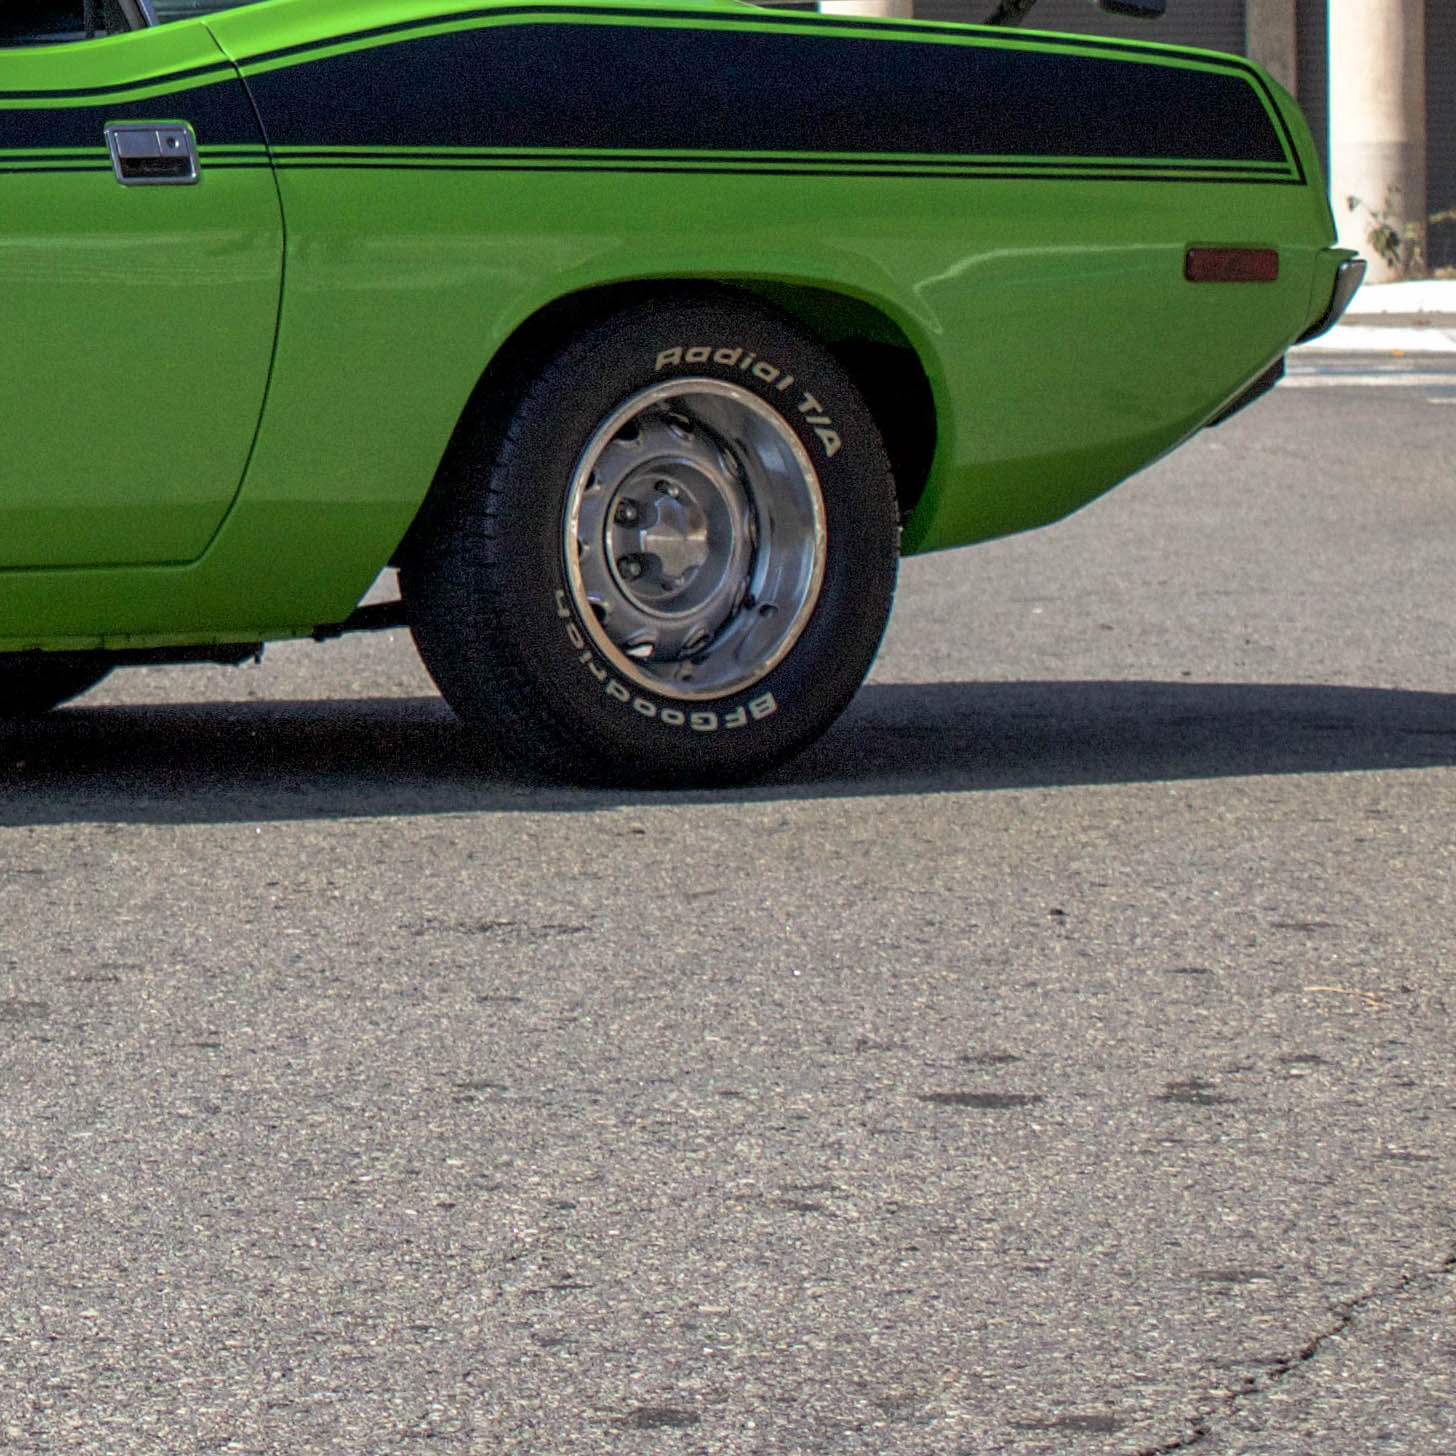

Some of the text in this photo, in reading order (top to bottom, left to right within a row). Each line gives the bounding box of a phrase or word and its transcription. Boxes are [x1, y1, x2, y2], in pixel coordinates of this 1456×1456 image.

[654, 345, 843, 458] Radial T/A
[554, 589, 778, 732] BFGoodrich
